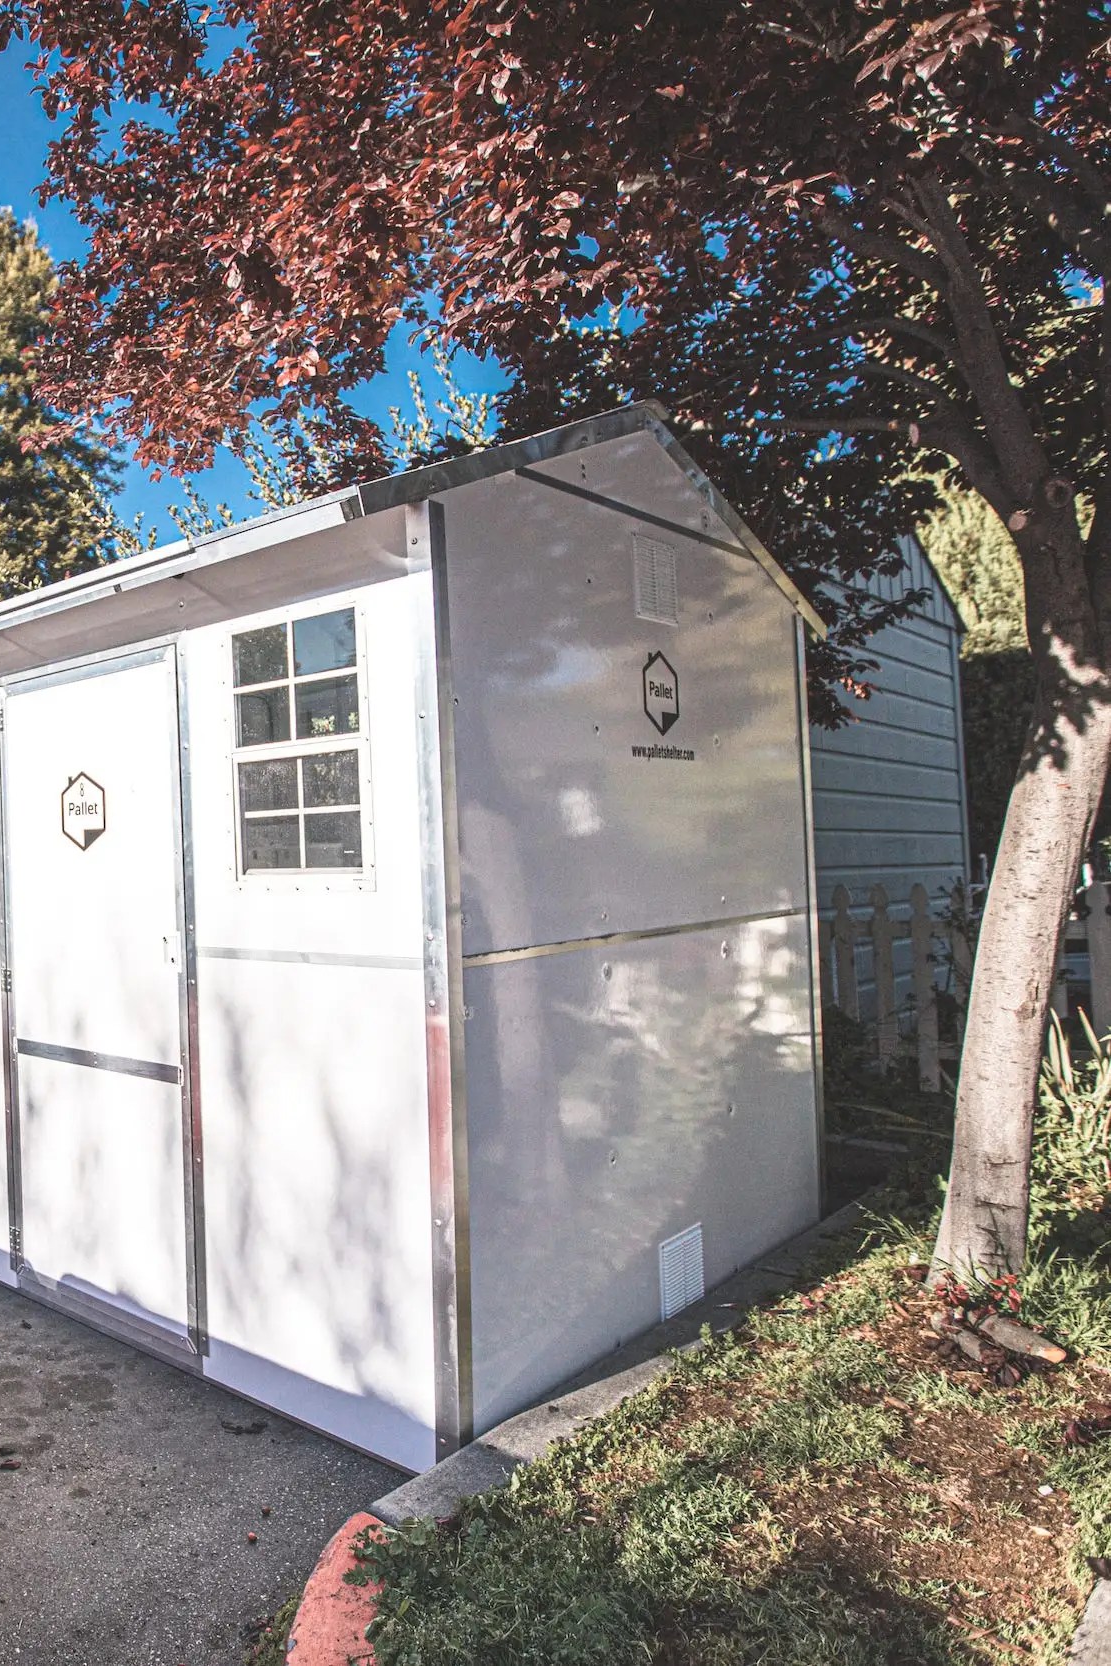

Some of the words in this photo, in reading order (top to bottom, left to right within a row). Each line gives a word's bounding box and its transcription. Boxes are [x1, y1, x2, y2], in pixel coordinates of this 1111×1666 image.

[649, 680, 673, 700] Pallet
[631, 744, 695, 761] www.palletshelter.com
[68, 801, 98, 816] Pallet
